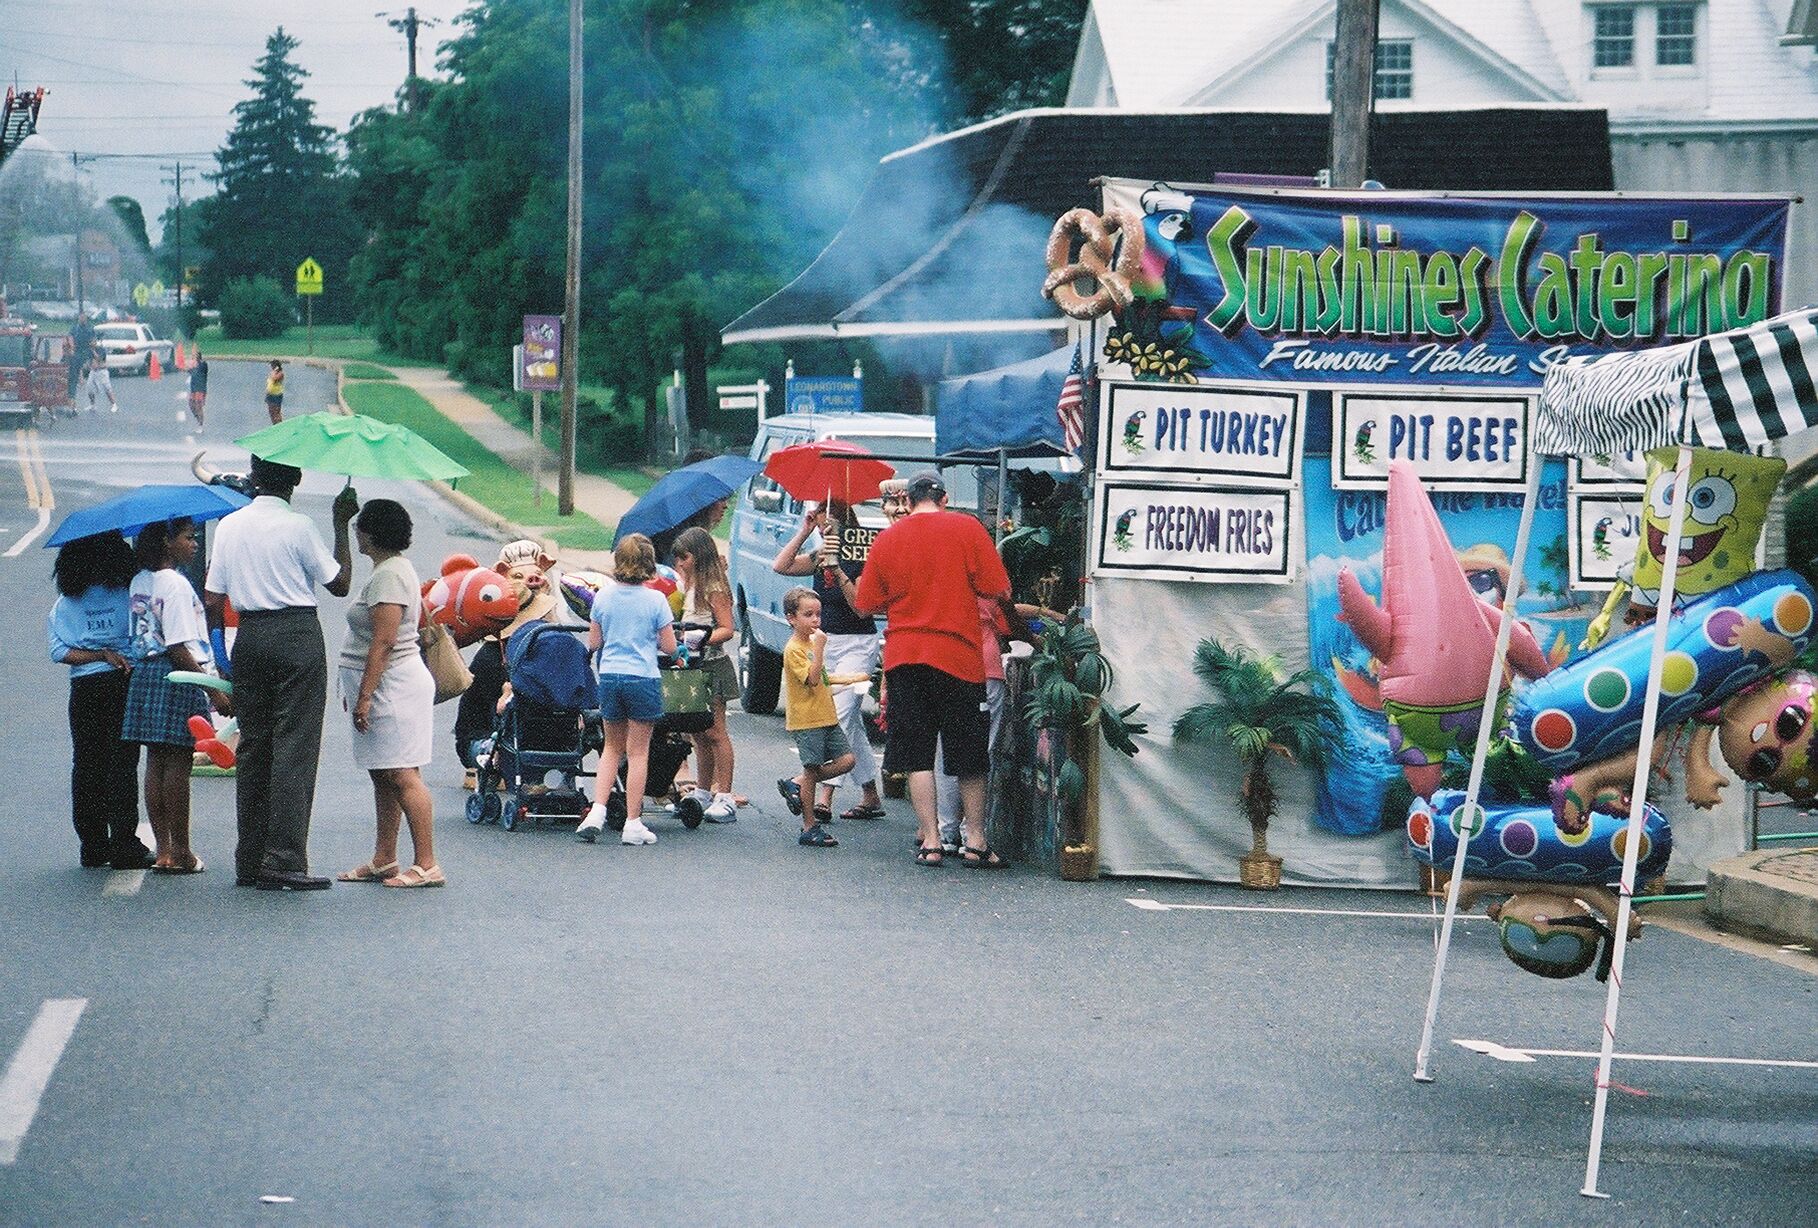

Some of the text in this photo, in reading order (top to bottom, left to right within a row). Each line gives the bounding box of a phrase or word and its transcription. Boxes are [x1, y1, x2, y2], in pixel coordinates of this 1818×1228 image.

[1203, 204, 1490, 337] Sunshines
[1258, 340, 1399, 373] Famous
[1406, 342, 1518, 375] Italian
[1154, 406, 1288, 458] PIT TURKEY
[1388, 414, 1518, 463] PIT BEEF
[844, 528, 879, 545] GRE
[1145, 505, 1275, 556] FREEDOM FRIES
